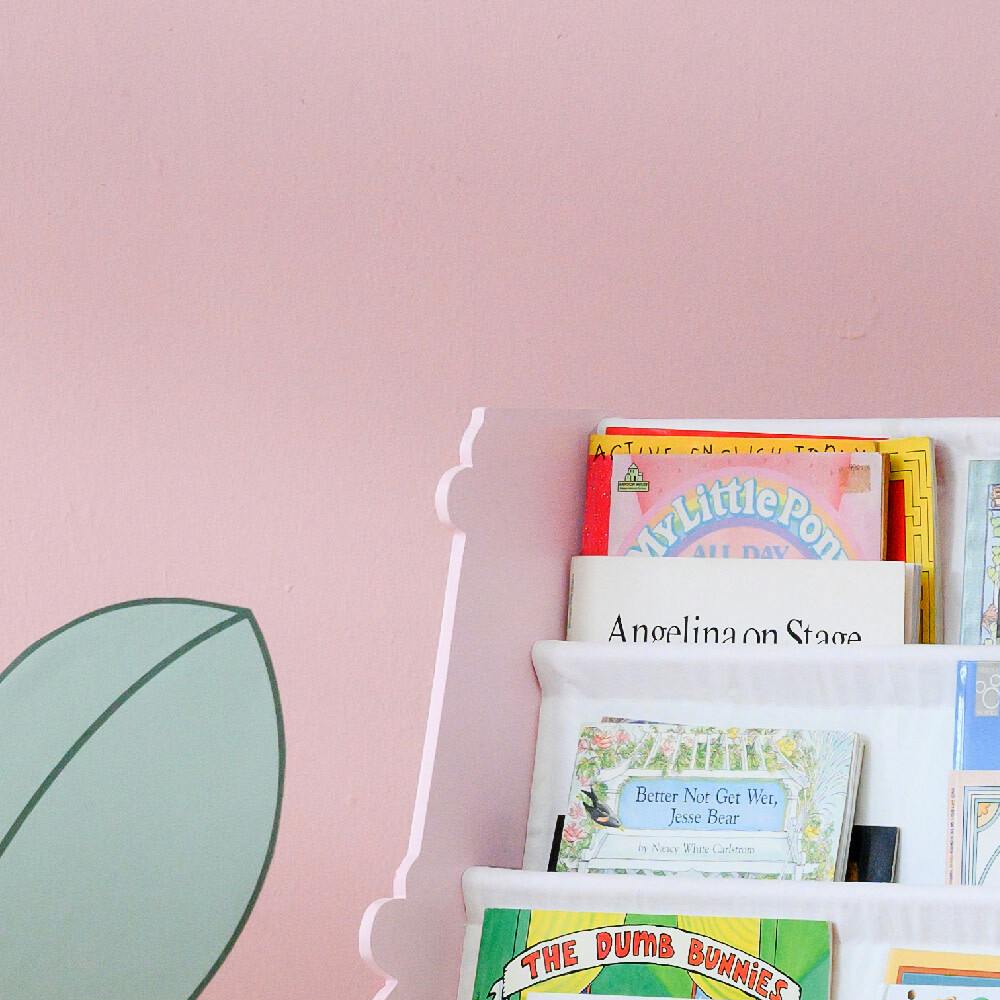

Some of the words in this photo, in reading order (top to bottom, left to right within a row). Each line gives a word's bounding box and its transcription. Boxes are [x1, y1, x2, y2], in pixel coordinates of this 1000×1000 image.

[672, 478, 779, 533] Little
[608, 613, 737, 643] Angelina
[743, 627, 778, 644] on
[635, 786, 679, 804] Better
[683, 786, 710, 804] Not
[715, 788, 741, 805] Get
[746, 787, 779, 806] Wet,
[668, 807, 702, 827] Jesse
[707, 807, 741, 826] Bear
[520, 940, 580, 980] THE
[596, 930, 676, 961] DUMB
